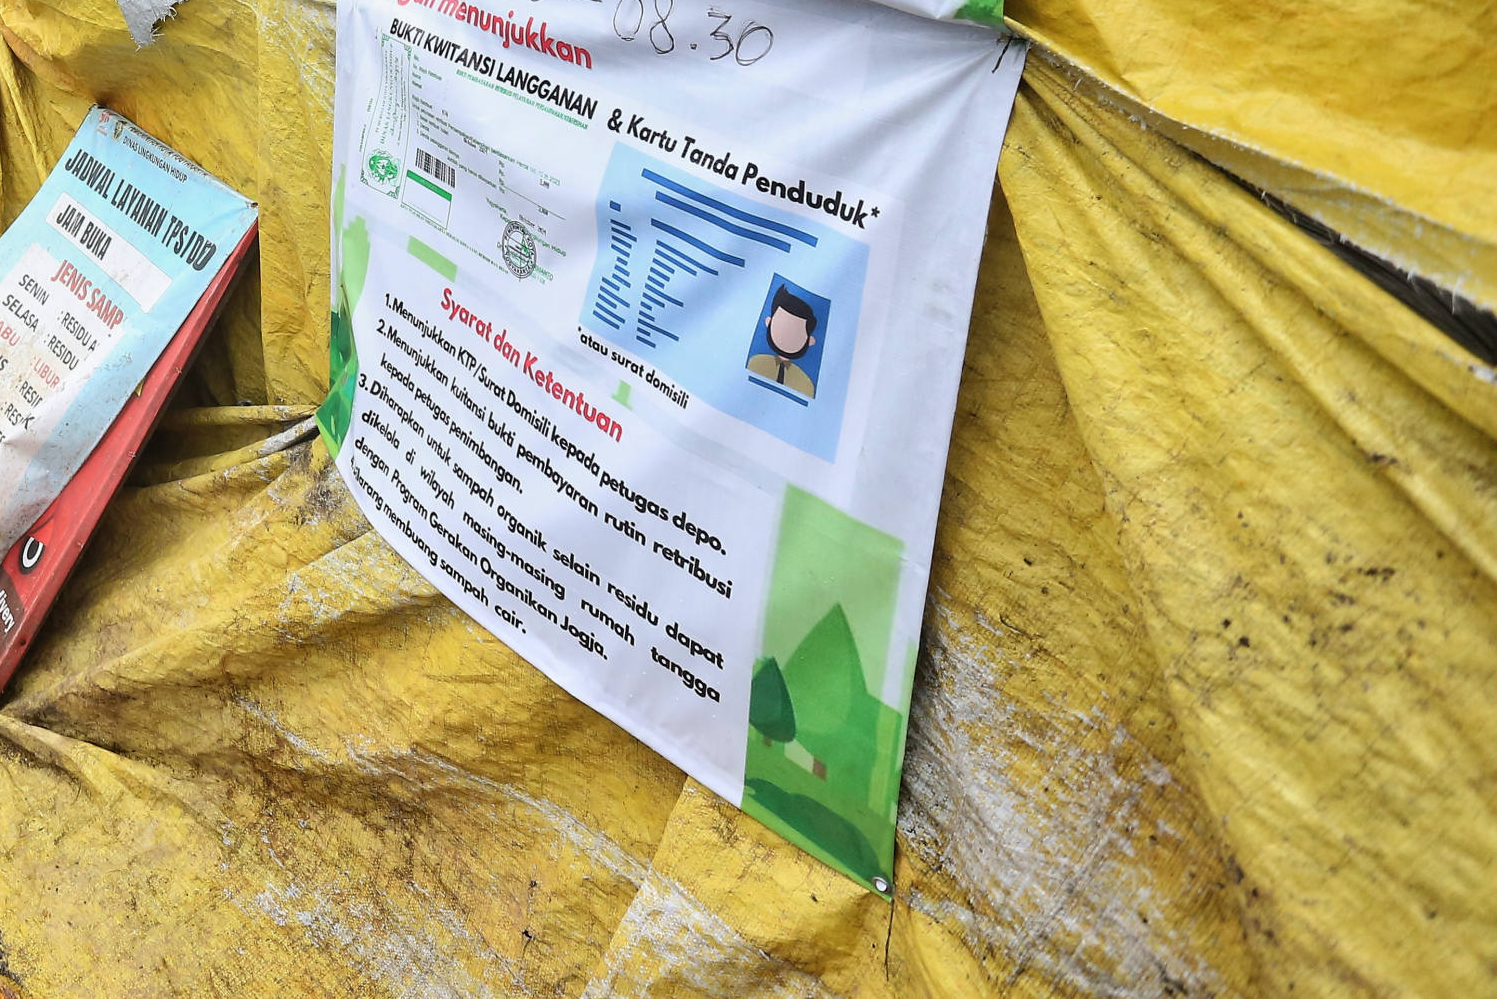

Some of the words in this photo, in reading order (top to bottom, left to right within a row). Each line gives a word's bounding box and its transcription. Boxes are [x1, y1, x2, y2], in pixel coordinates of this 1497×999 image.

[389, 17, 424, 48] BUKTI
[423, 32, 496, 77] KWITANSI
[496, 60, 598, 121] LANGGANAN
[122, 135, 138, 152] DINAS
[170, 166, 188, 183] HIDUP
[607, 108, 622, 133] &
[627, 114, 677, 154] Kartu
[681, 136, 739, 180] Tanda
[56, 204, 86, 238] JAM
[80, 221, 113, 261] BUKA
[64, 149, 116, 200] JADWAL
[110, 179, 168, 238] LAYANAN
[2, 294, 39, 332] SELASA
[47, 335, 80, 371] RESIDU
[18, 274, 50, 306] SENIN
[61, 311, 90, 347] RESIDU
[51, 259, 93, 301] JENIS
[86, 288, 125, 330] SAMP
[33, 357, 60, 389] LIBUR
[441, 288, 492, 342] Syarat
[494, 329, 521, 368] dan
[523, 352, 623, 442] Ketentuan
[611, 351, 644, 378] surat
[645, 369, 689, 409] domisili
[380, 353, 415, 393] kepada
[415, 388, 451, 426] petugas
[449, 420, 523, 494] penimbangan.
[457, 347, 507, 401] KTP/Surat
[508, 390, 551, 438] Domisili
[551, 425, 600, 477] kepada
[600, 470, 669, 522] petugas
[672, 512, 727, 556] depo.
[370, 380, 425, 438] Diharapkan
[427, 434, 451, 466] untuk
[452, 463, 494, 507] sampah
[497, 505, 548, 553] organik
[553, 548, 600, 587] selain
[607, 582, 659, 626] residu
[665, 622, 724, 670] dapat
[451, 377, 487, 421] kuitansi
[488, 412, 517, 448] bukti
[516, 443, 598, 517] pembayaran
[604, 512, 646, 546] rutin
[653, 540, 733, 599] retribusi
[355, 437, 390, 476] dengan
[391, 469, 428, 521] Program
[429, 511, 478, 565] Gerakan
[480, 556, 557, 624] Organikan
[560, 615, 608, 660] Jogja.
[361, 410, 400, 450] dikelola
[405, 449, 416, 465] di
[420, 466, 455, 510] wilayah
[462, 511, 566, 600] masing-masing
[581, 598, 635, 646] rumah
[651, 646, 721, 703] tangga
[383, 503, 438, 566] membuang
[439, 557, 489, 607] sampah
[494, 602, 527, 634] cair.
